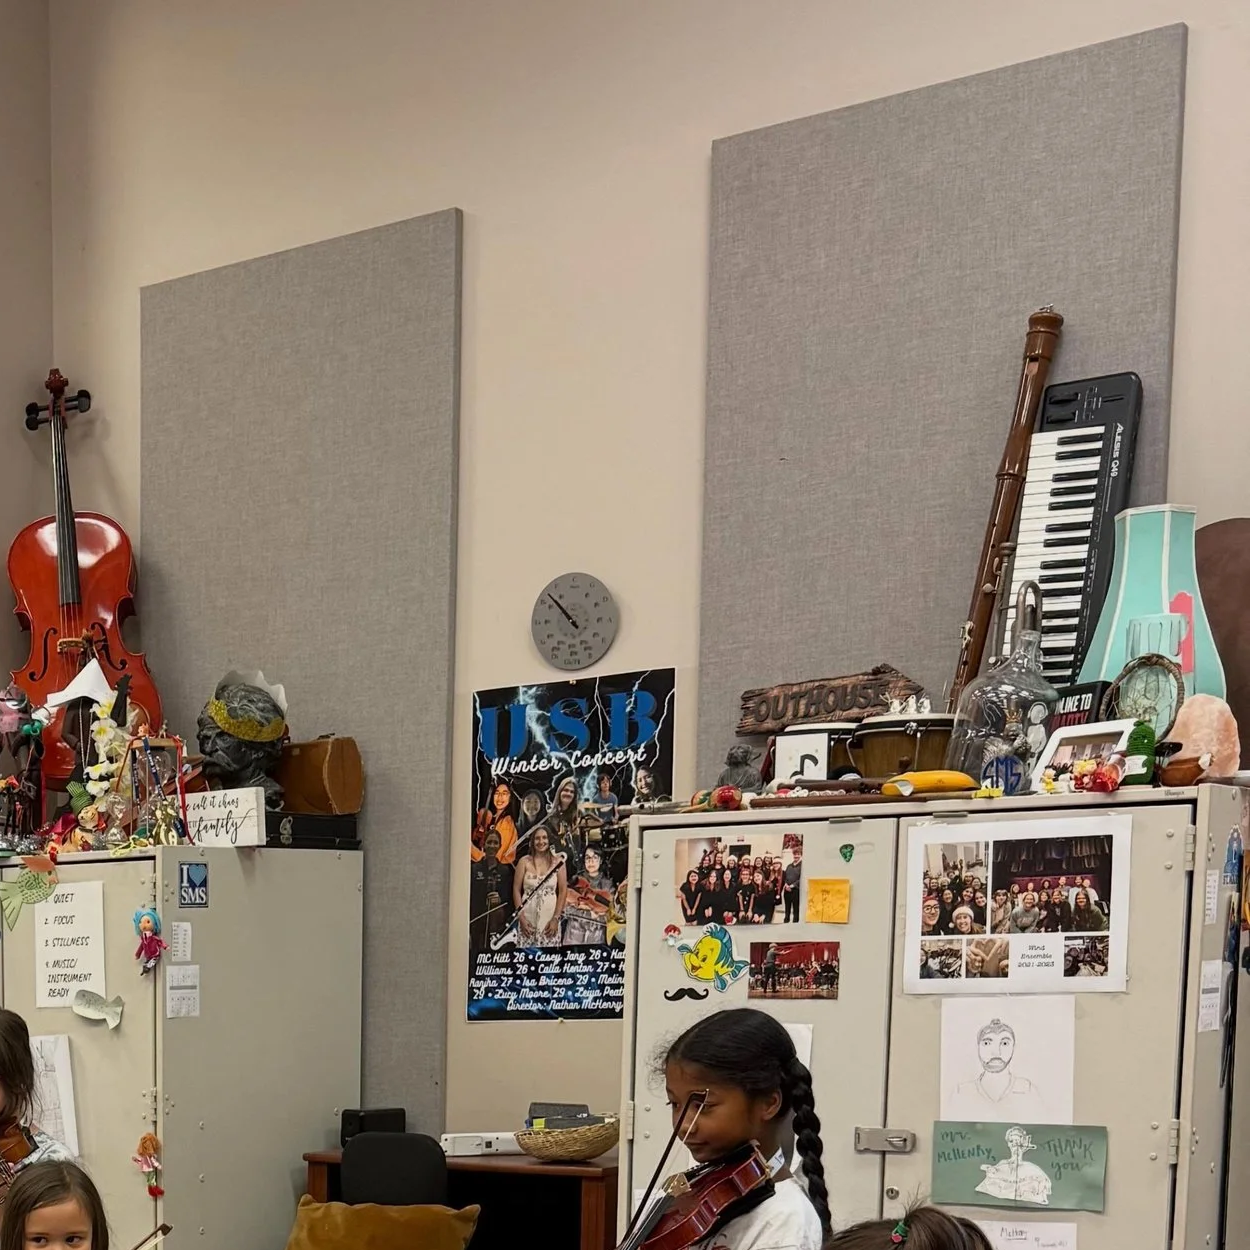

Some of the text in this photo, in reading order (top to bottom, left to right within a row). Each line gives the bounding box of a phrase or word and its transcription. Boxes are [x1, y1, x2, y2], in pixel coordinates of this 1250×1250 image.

[754, 681, 889, 722] OUTHOUSE
[1080, 693, 1092, 710] TO
[480, 690, 658, 760] USB
[492, 748, 647, 775] Winter Concert
[193, 792, 239, 810] call it chaos
[193, 808, 250, 844] family
[181, 864, 190, 886] I
[54, 893, 75, 904] QUIET
[181, 886, 206, 904] SMS
[54, 915, 75, 925] FOCUS
[52, 936, 90, 947] STILLNESS
[535, 951, 562, 964] Casey
[475, 965, 513, 975] Williams
[48, 972, 92, 984] INSTRUMENT
[522, 976, 537, 986] Isa
[48, 988, 69, 998] READY
[519, 988, 550, 999] Moore
[507, 1000, 624, 1012] Director: Nathan McHenry
[1044, 1136, 1094, 1160] THANK
[1050, 1161, 1082, 1180] you
